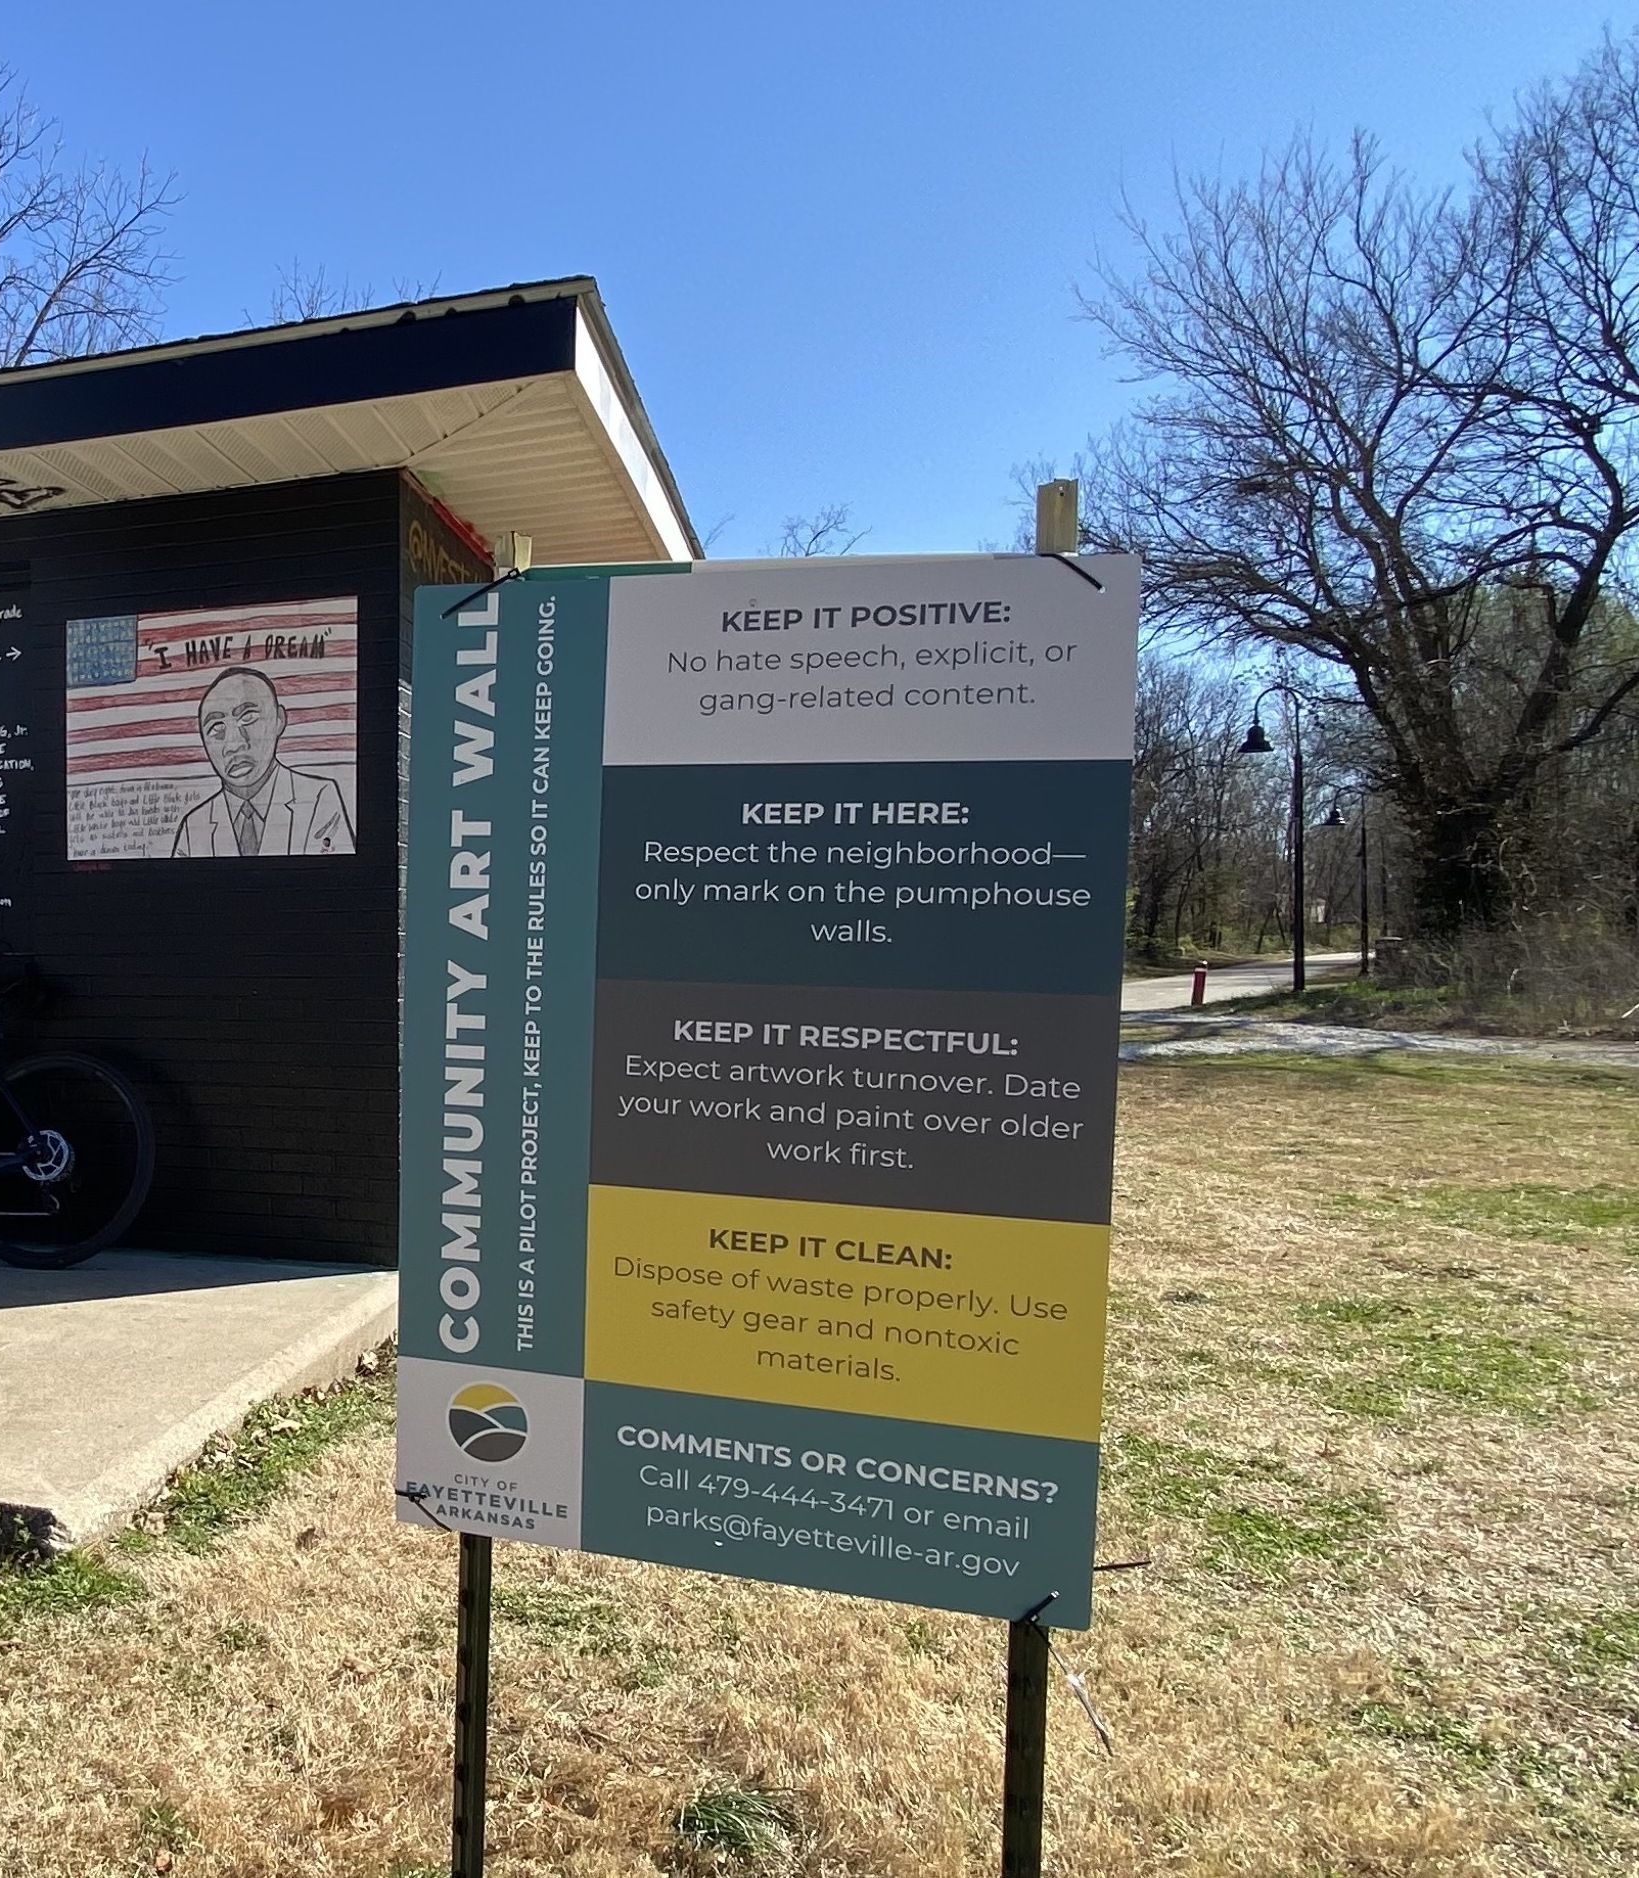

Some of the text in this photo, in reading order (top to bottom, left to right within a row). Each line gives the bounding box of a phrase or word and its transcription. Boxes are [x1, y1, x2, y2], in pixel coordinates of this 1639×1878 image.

[721, 601, 1011, 632] KEEP IT POSITIVE:
[185, 635, 233, 667] HAVE
[242, 634, 251, 660] A
[667, 639, 1077, 674] No hate speech, explicit, or
[699, 683, 1035, 716] gang-related content.
[742, 802, 970, 824] KEEP IT HERE:
[644, 841, 1087, 869] Respect the neighborhood—
[635, 879, 1092, 909] only mark on the pumphouse
[810, 920, 893, 943] walls.
[439, 592, 499, 1353] COMMUNITY ART WALL
[516, 595, 556, 1352] THIS IS A PILOT PROJECT, KEEP TO THE RULES SO IT CAN KEEP GOING.
[674, 1020, 1019, 1056] KEEP IT RESPECTFUL:
[625, 1055, 1082, 1100] Expect artwork turnover. Date
[617, 1093, 1084, 1140] your work and paint over older
[766, 1140, 914, 1170] work first.
[709, 1228, 952, 1270] KEEP IT CLEAN:
[614, 1256, 1069, 1321] Dispose of waste properly. Use
[650, 1297, 1020, 1356] safety gear and nontoxic
[757, 1346, 902, 1383] materials.
[617, 1425, 1059, 1504] COMMENTS OR CONCERNS?
[406, 1481, 568, 1519] FAYETTEVILLE
[454, 1474, 518, 1492] CITY OF
[436, 1504, 535, 1530] ARKANSAS
[639, 1464, 1029, 1539] Call 479-444-3471 or email
[646, 1503, 1020, 1578] parks@fayetteville-ar.gov
